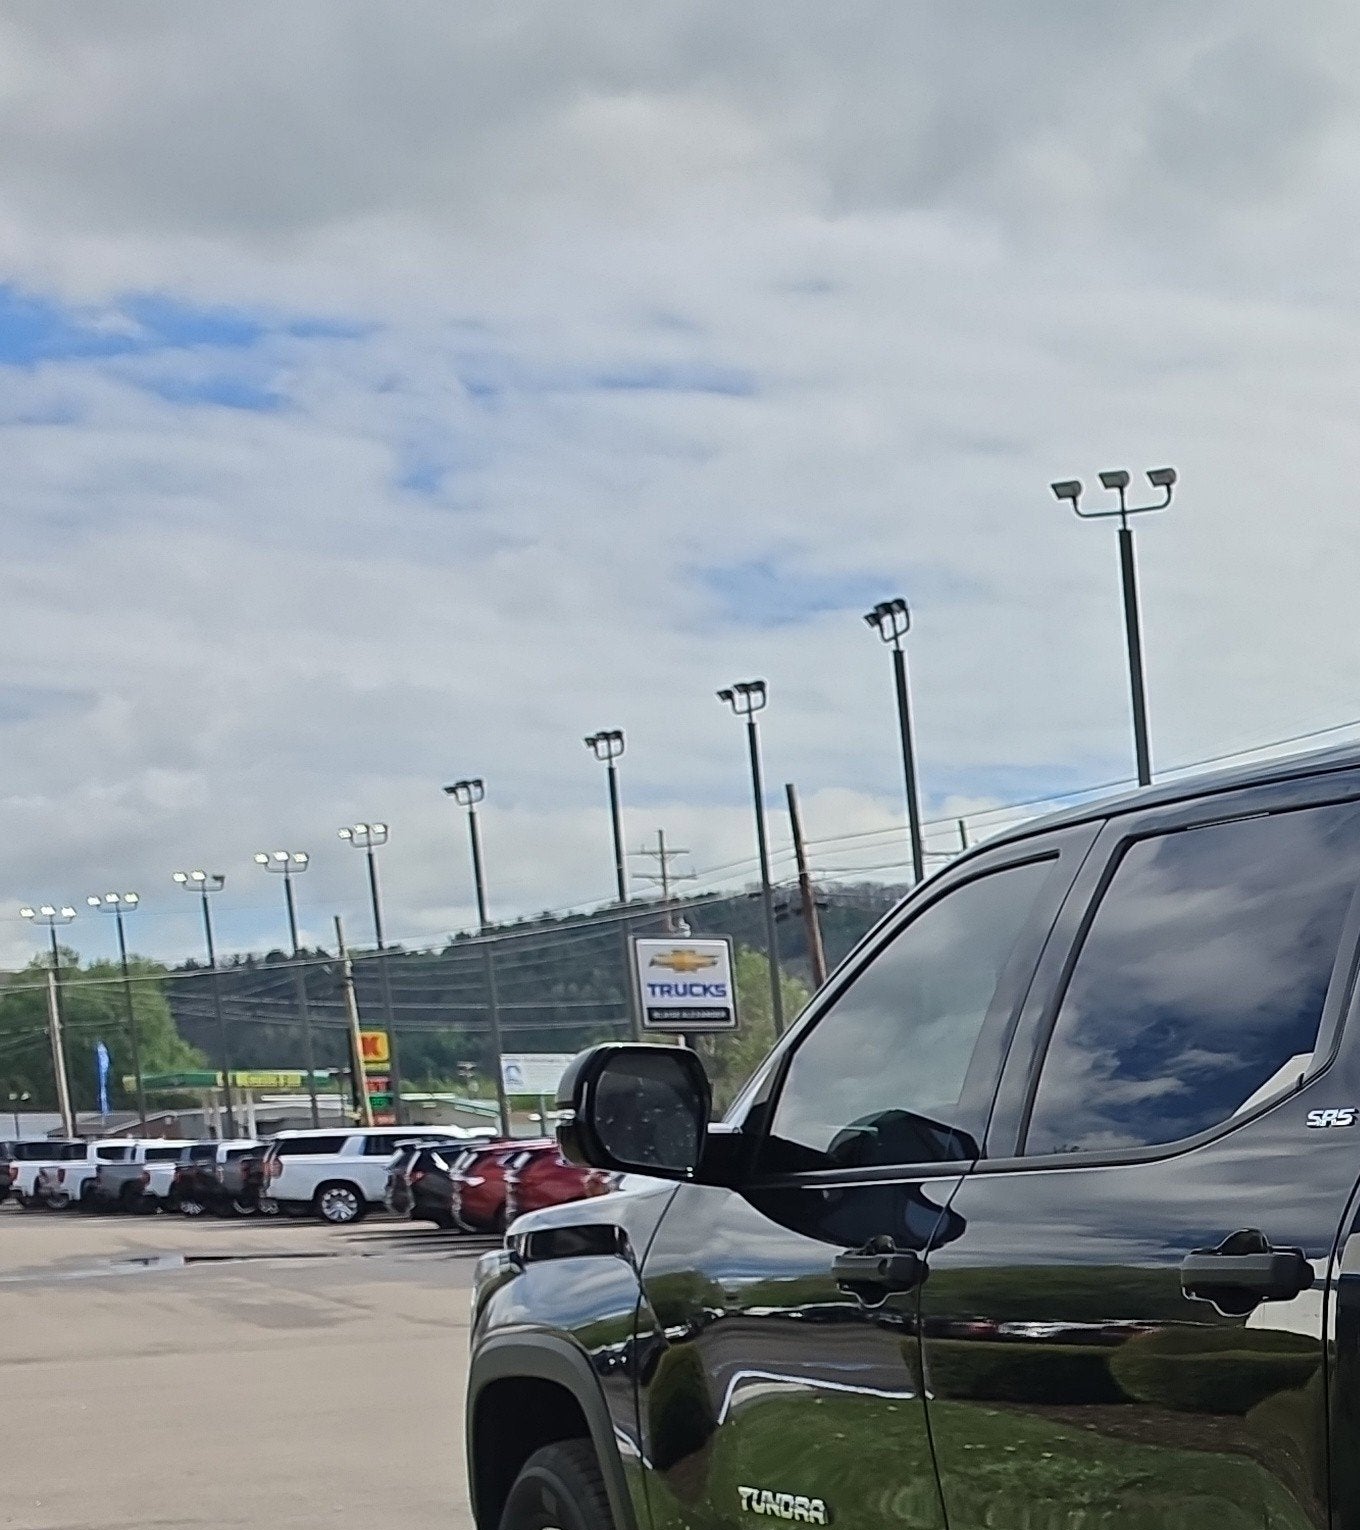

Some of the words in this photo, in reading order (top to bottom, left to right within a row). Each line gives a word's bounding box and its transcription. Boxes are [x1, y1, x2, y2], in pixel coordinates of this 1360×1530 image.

[647, 983, 727, 998] TRUCKS
[1306, 1108, 1357, 1127] SR5
[737, 1486, 826, 1525] TUNDRA
